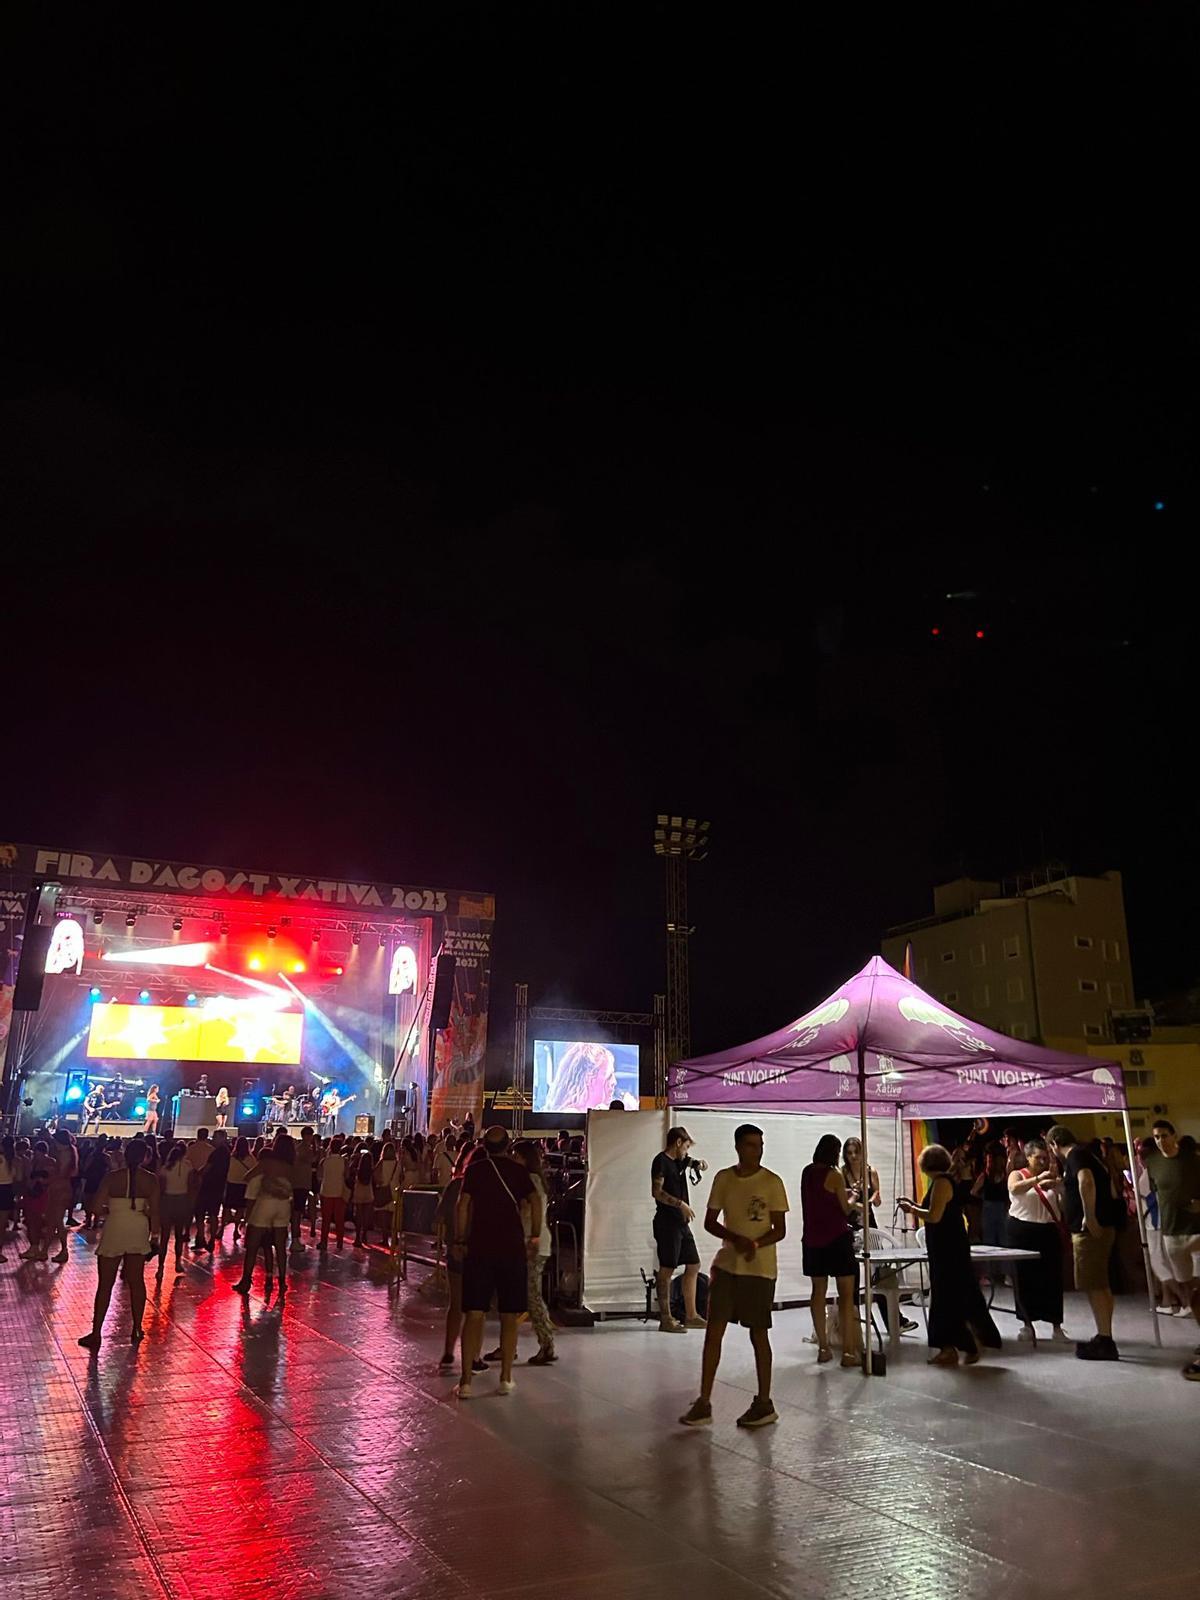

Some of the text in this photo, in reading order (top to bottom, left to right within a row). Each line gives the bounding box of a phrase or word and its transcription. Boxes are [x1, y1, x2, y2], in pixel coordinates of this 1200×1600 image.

[35, 850, 120, 881] FIRA
[129, 861, 269, 896] D'AGOST
[392, 887, 447, 912] 2023
[723, 1069, 788, 1086] PUNT VIOLETA
[956, 1069, 1045, 1088] PUNT VIOLETA
